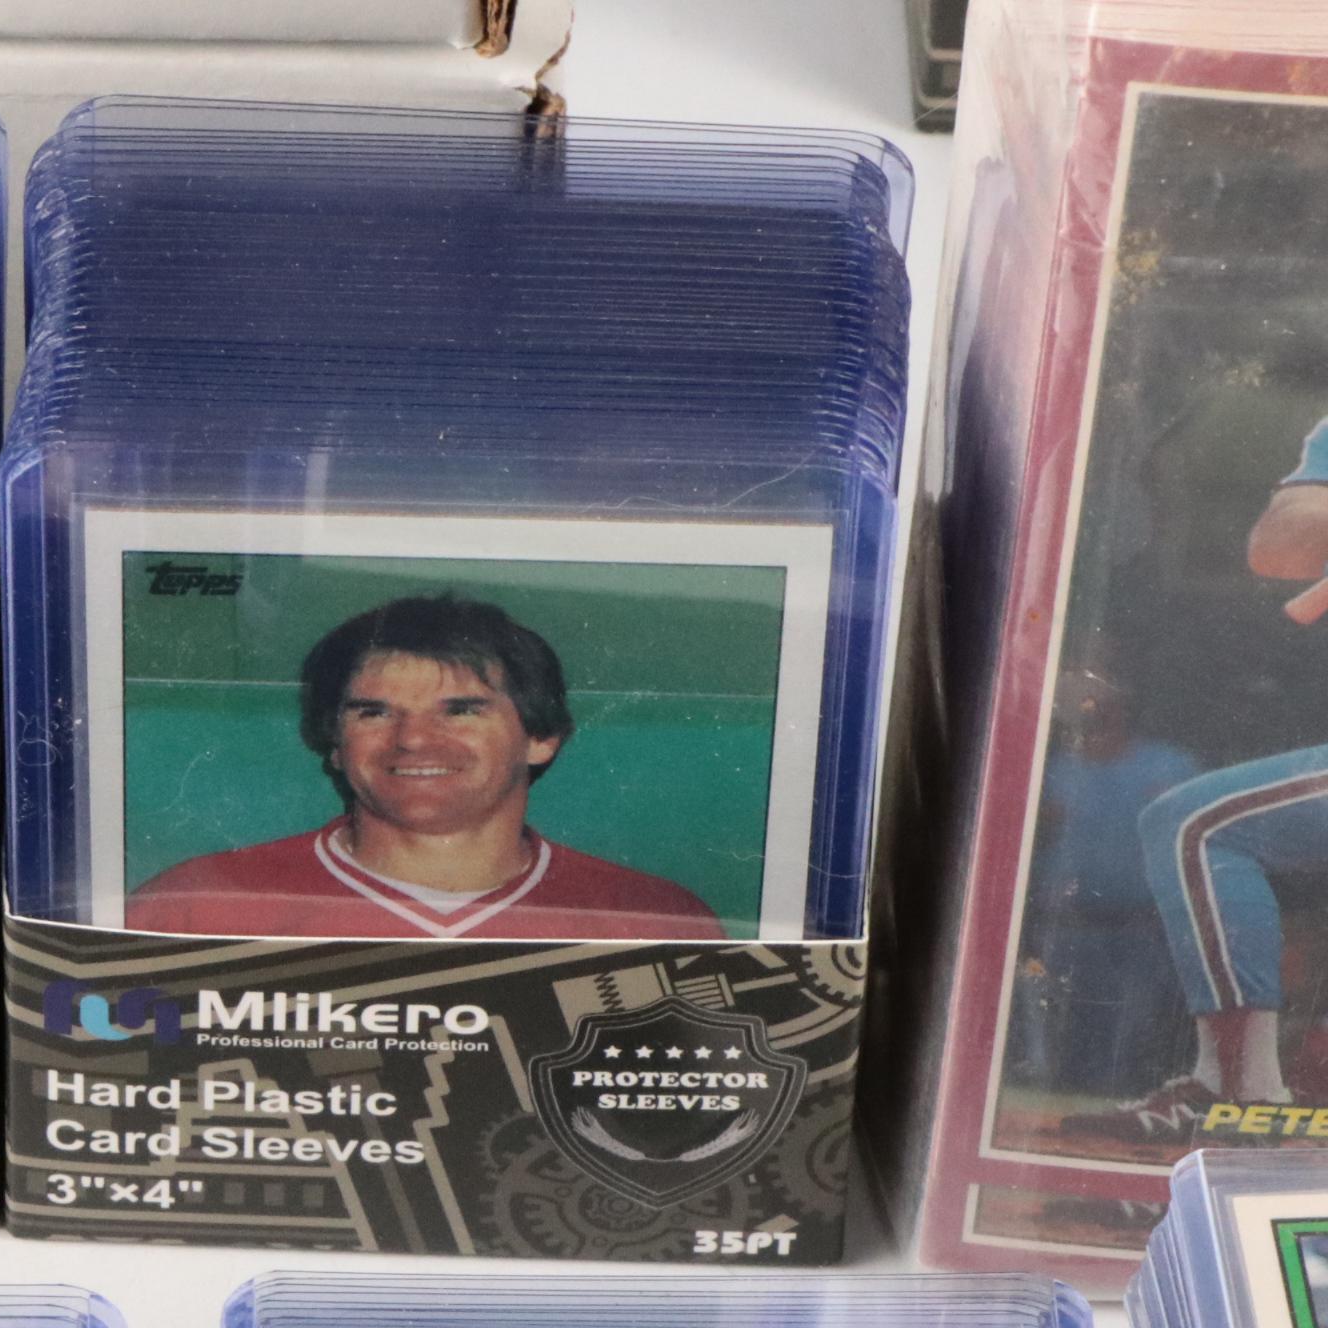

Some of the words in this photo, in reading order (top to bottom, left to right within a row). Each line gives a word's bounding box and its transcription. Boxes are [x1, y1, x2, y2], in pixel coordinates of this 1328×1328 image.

[197, 990, 490, 1035] Mlikero
[196, 1033, 325, 1050] Professional
[330, 1037, 378, 1050] Card
[384, 1038, 489, 1051] Protection
[47, 1069, 181, 1109] Hard
[203, 1079, 396, 1116] Plastic
[572, 1071, 769, 1089] PROTECTOR
[598, 1093, 740, 1111] SLEEVES
[46, 1119, 180, 1156] Card
[202, 1127, 424, 1164] Sleeves
[693, 1230, 797, 1255] 35PT
